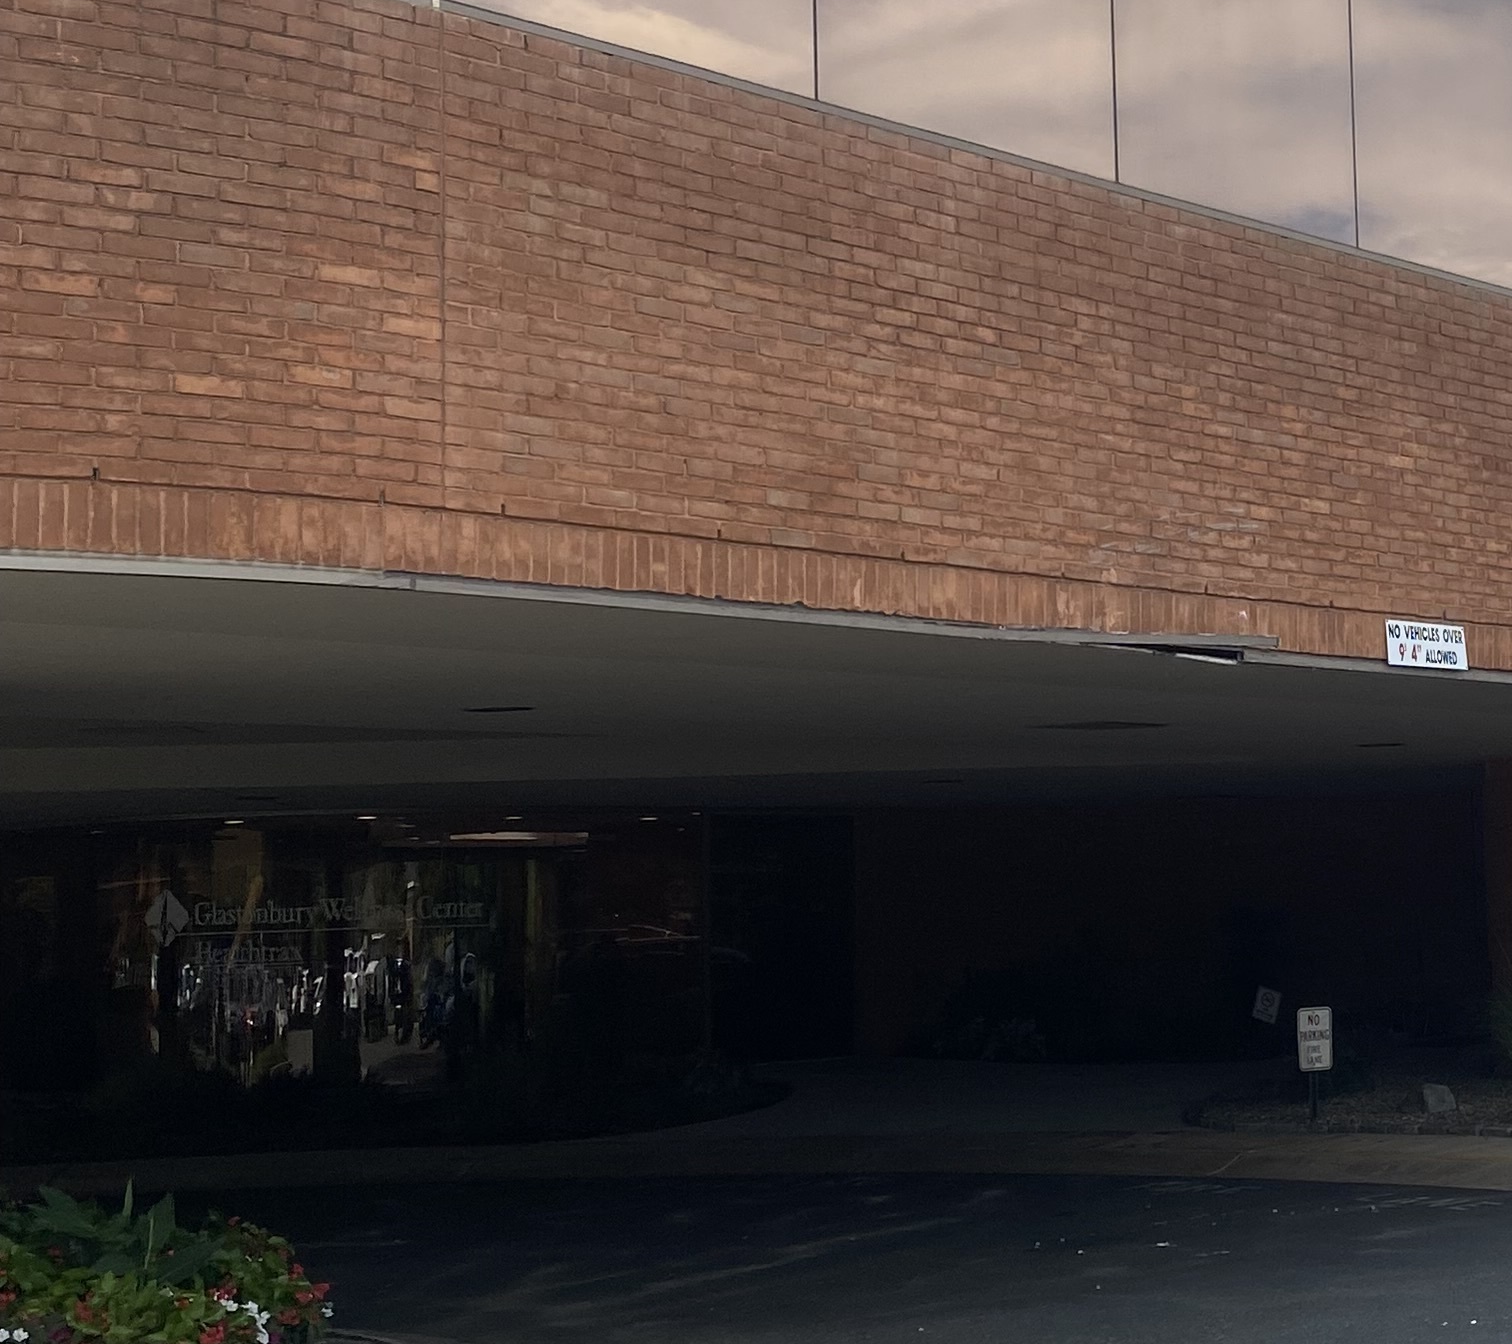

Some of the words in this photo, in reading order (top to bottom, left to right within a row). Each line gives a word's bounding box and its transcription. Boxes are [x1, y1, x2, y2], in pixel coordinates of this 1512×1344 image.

[1388, 623, 1401, 639] NO
[1403, 624, 1440, 643] VEHICLES
[1442, 628, 1464, 644] OVER
[1398, 642, 1407, 662] 9'
[1425, 649, 1458, 665] ALLOWED
[194, 899, 316, 928] Glastonbury
[319, 896, 405, 921] Welness
[1307, 1014, 1320, 1026] NO
[1299, 1029, 1330, 1042] PARKING
